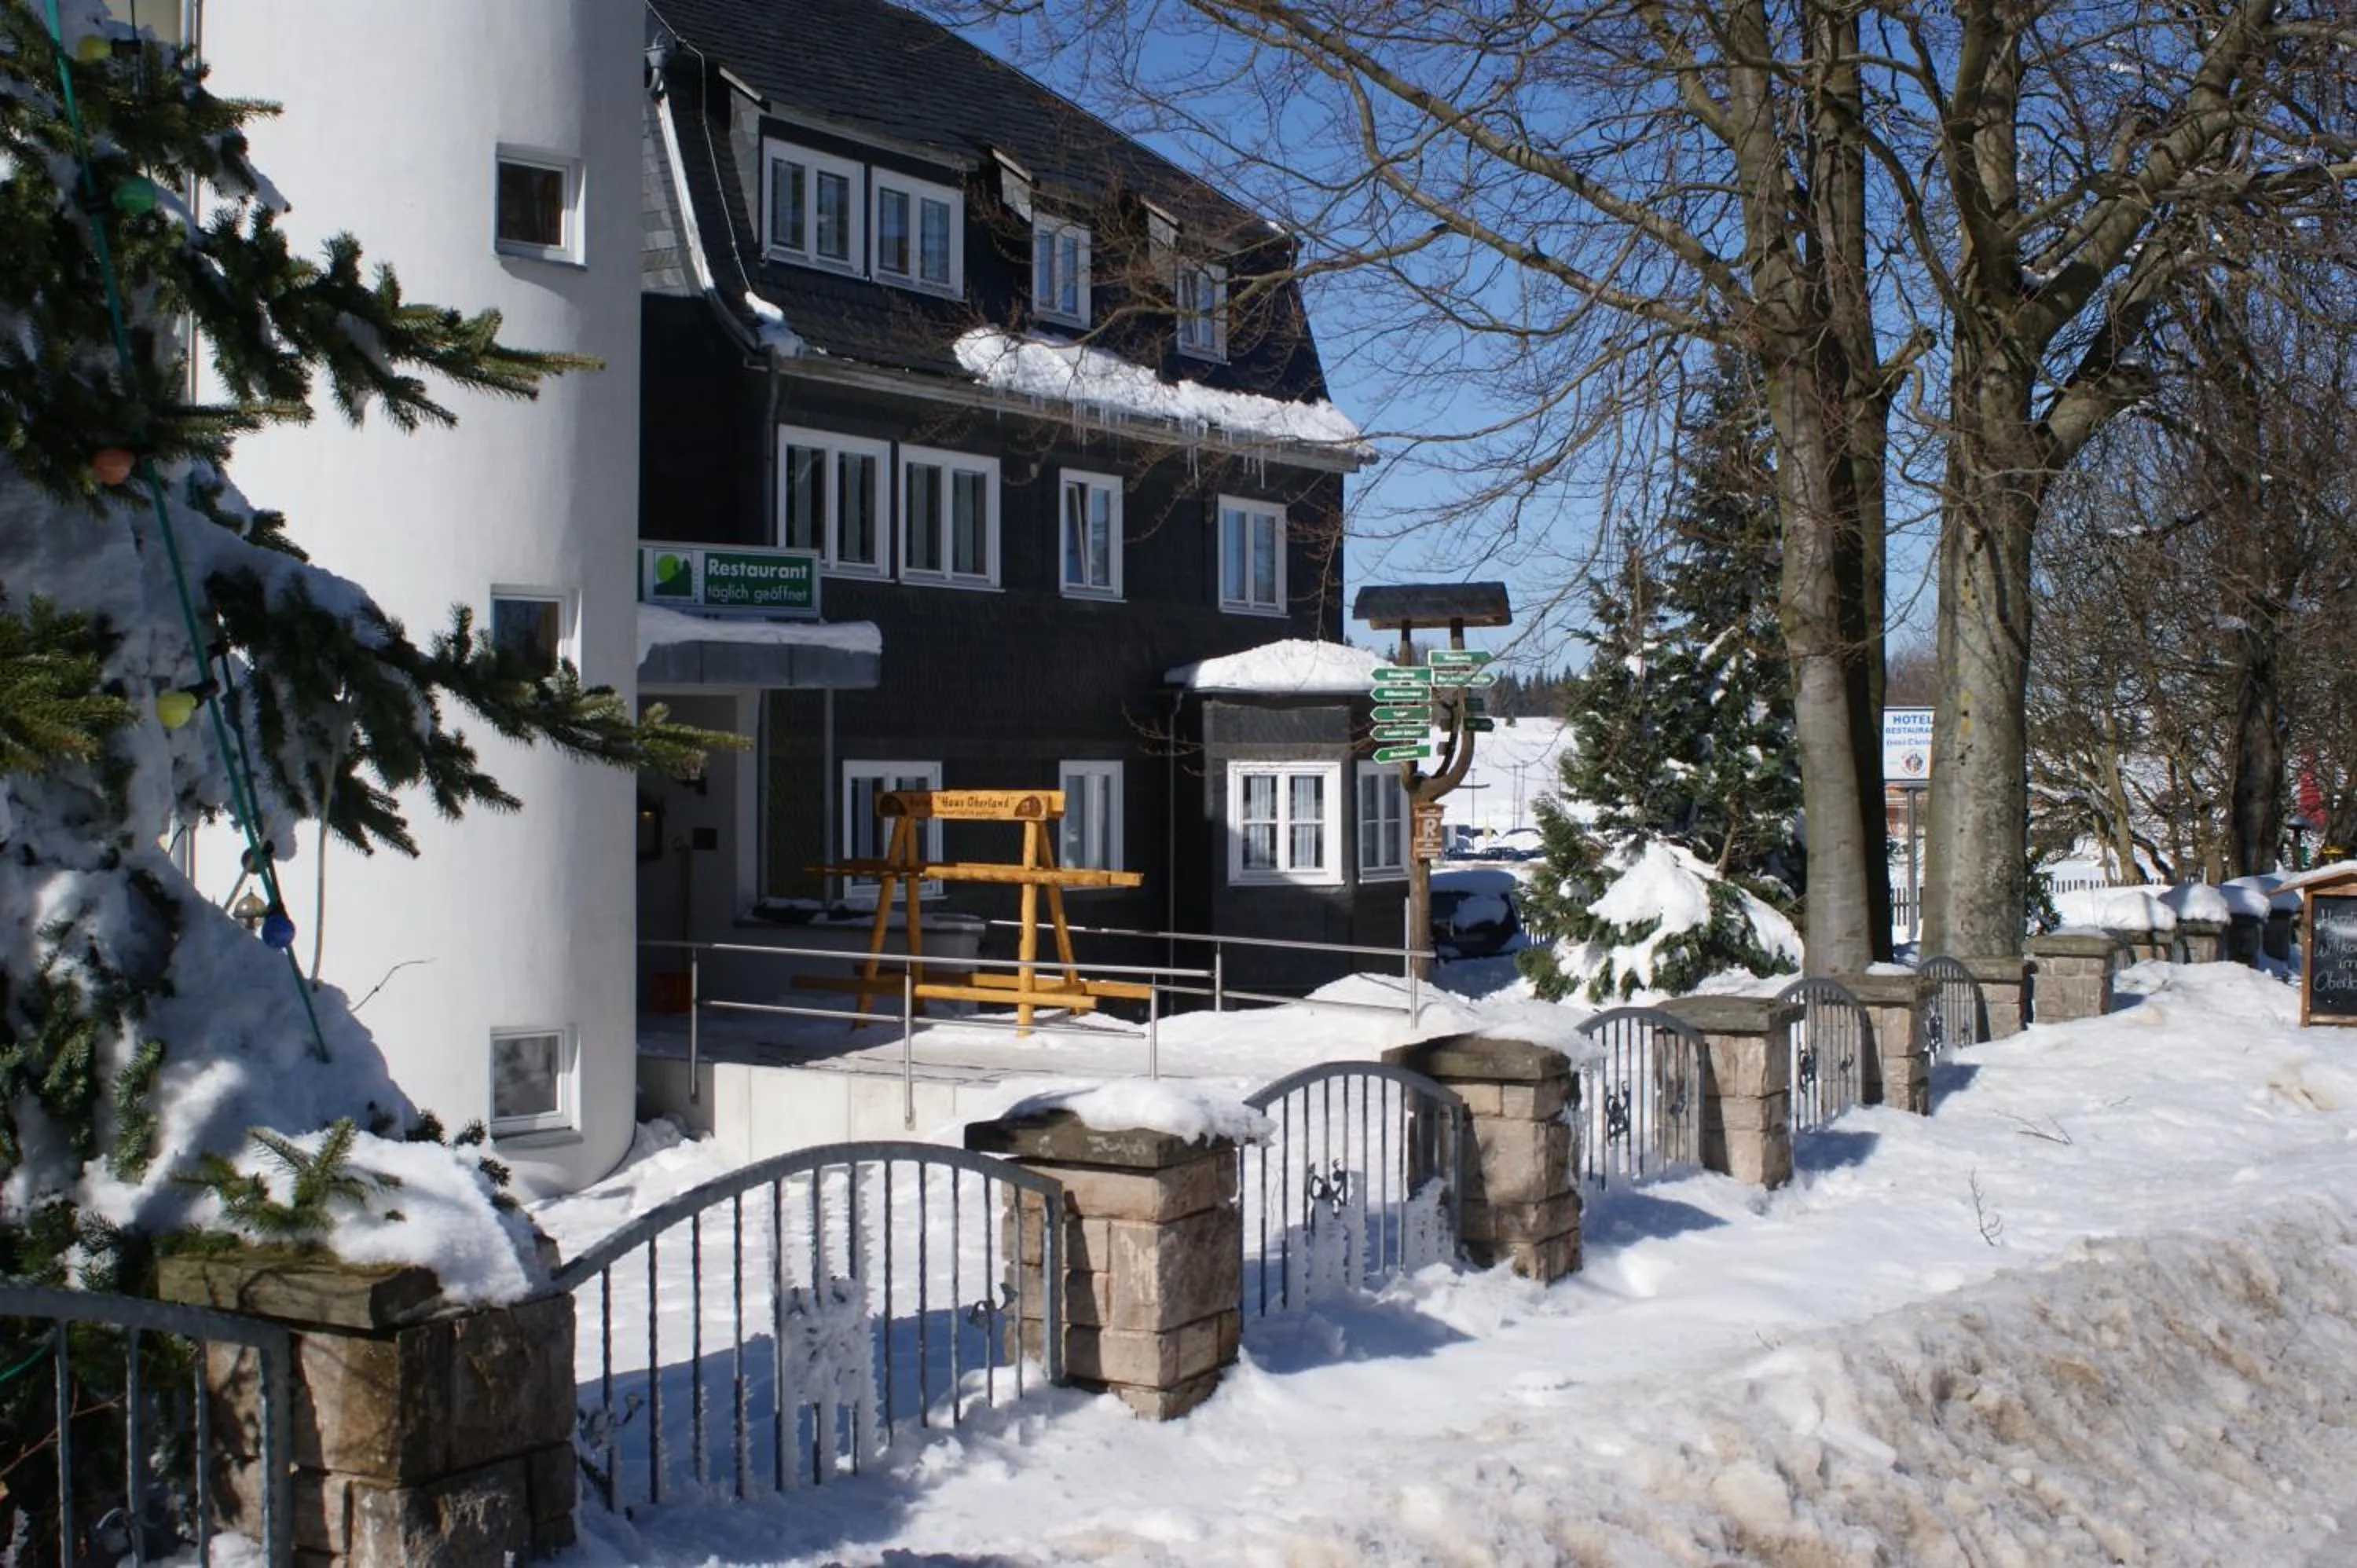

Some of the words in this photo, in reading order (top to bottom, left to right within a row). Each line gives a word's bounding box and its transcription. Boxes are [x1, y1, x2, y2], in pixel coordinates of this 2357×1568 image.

[709, 559, 807, 579] Restaurant
[707, 584, 749, 603] täglich
[754, 584, 807, 603] geöffnet
[1893, 715, 1932, 724] HOTEL
